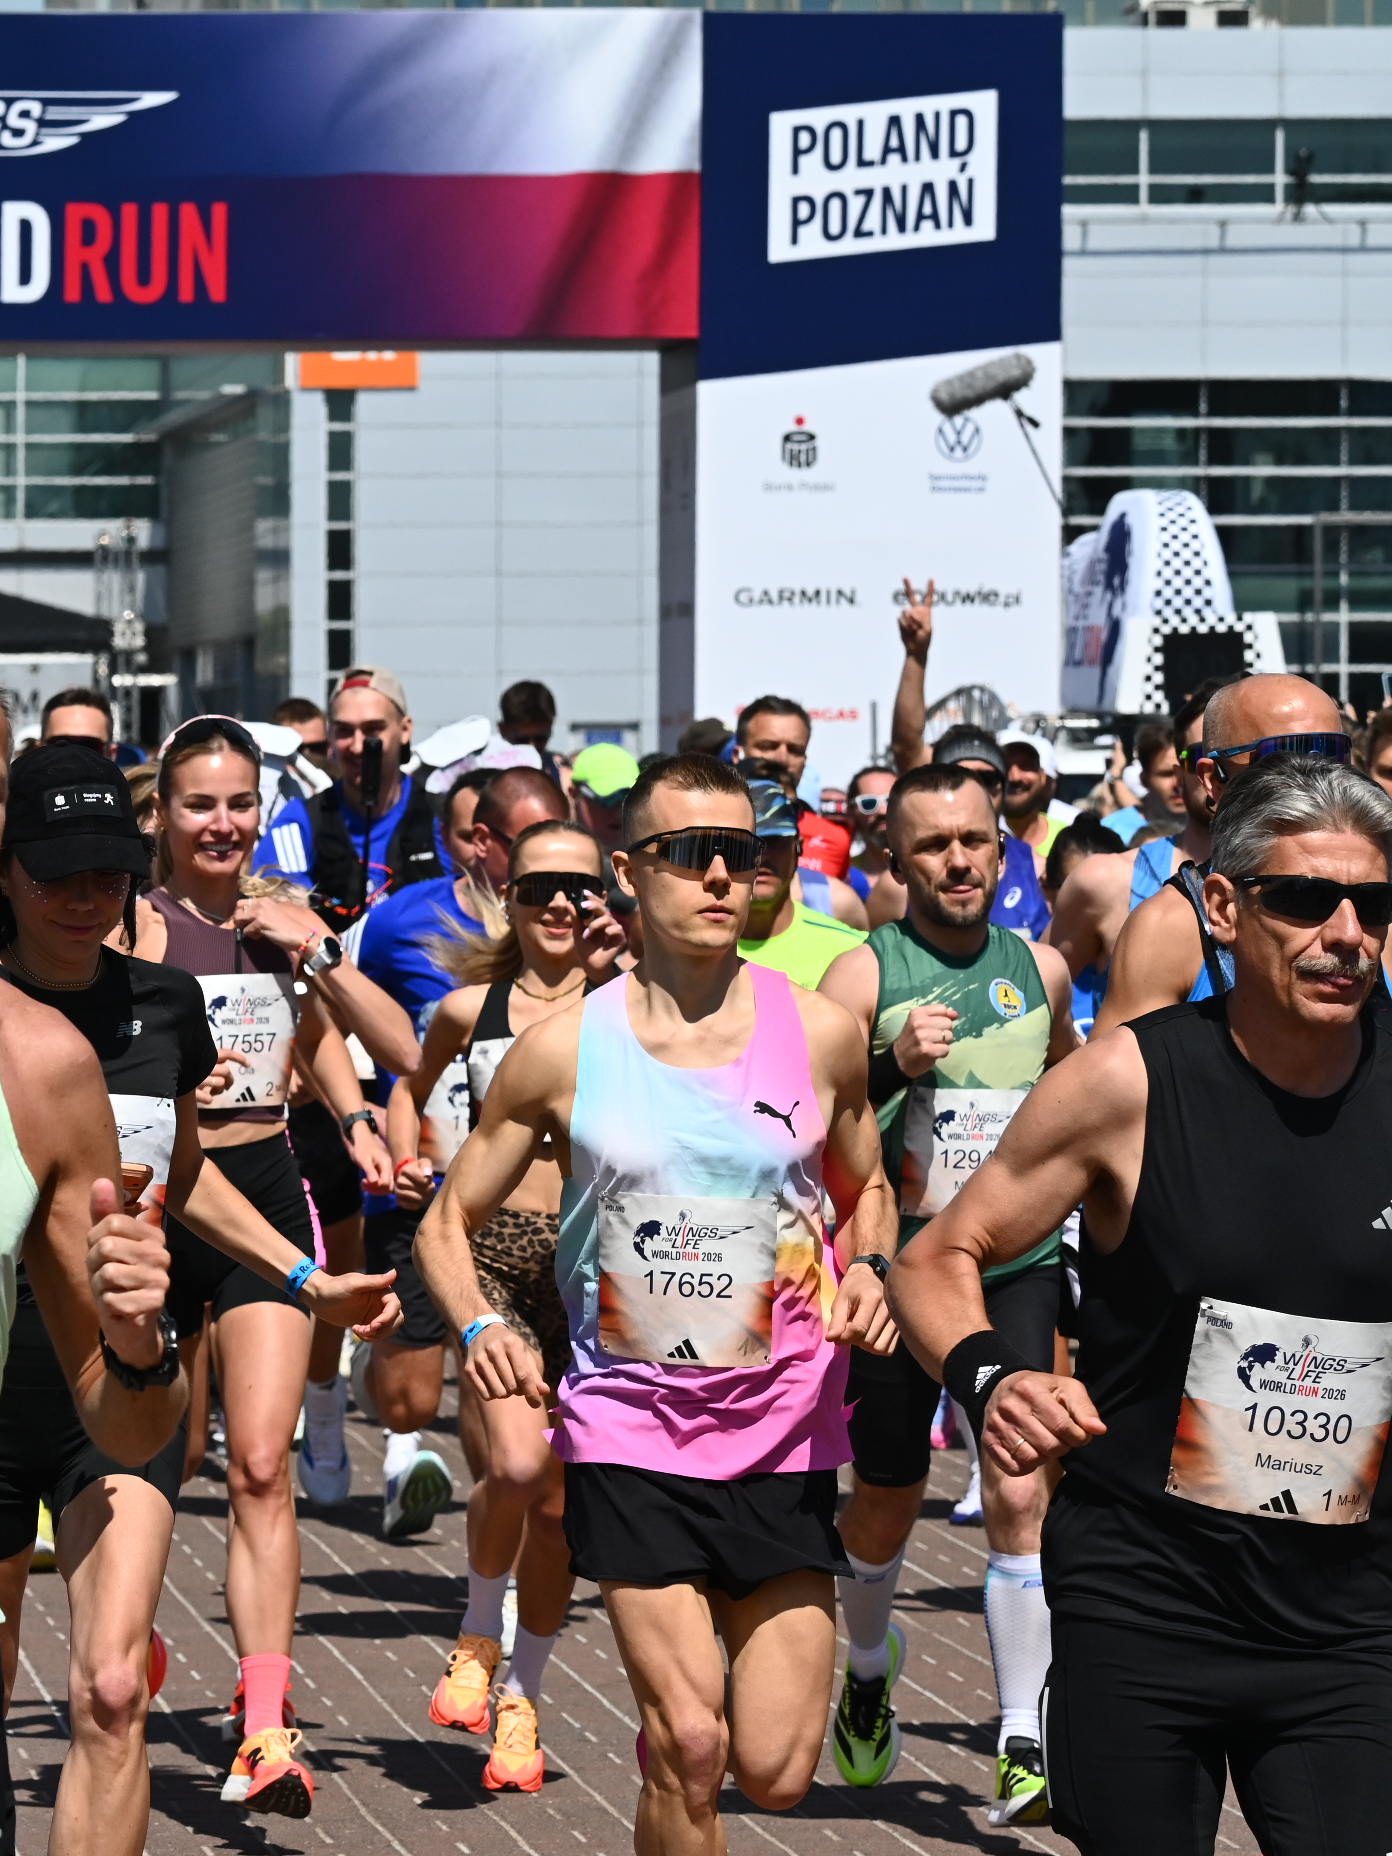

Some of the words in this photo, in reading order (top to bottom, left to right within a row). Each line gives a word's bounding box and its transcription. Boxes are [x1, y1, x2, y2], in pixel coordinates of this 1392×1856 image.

[790, 107, 975, 176] POLAND
[790, 161, 974, 246] POZNAŃ
[63, 202, 229, 304] RUN
[734, 587, 857, 607] GARMIN
[230, 996, 269, 1008] WINGS
[215, 1032, 277, 1054] 17557
[959, 1111, 998, 1123] WINGS
[963, 1122, 987, 1132] LIFE
[947, 1132, 970, 1141] WORLD
[605, 1204, 625, 1214] POLAND
[665, 1224, 720, 1239] WINGS
[671, 1238, 703, 1250] LIFE
[651, 1249, 681, 1261] WORLD
[681, 1251, 700, 1262] RUN
[701, 1252, 723, 1262] 2026
[643, 1269, 733, 1299] 17652
[1275, 1364, 1290, 1373] FOR
[1282, 1350, 1348, 1372] WINGS
[1286, 1369, 1327, 1384] LIFE
[1258, 1378, 1296, 1395] WORLD
[1296, 1383, 1319, 1398] RUN
[1320, 1387, 1347, 1401] 2026
[1243, 1402, 1353, 1445] 10330
[1255, 1452, 1324, 1477] Mariusz
[1322, 1488, 1333, 1512] 1
[1337, 1493, 1361, 1507] M-M
